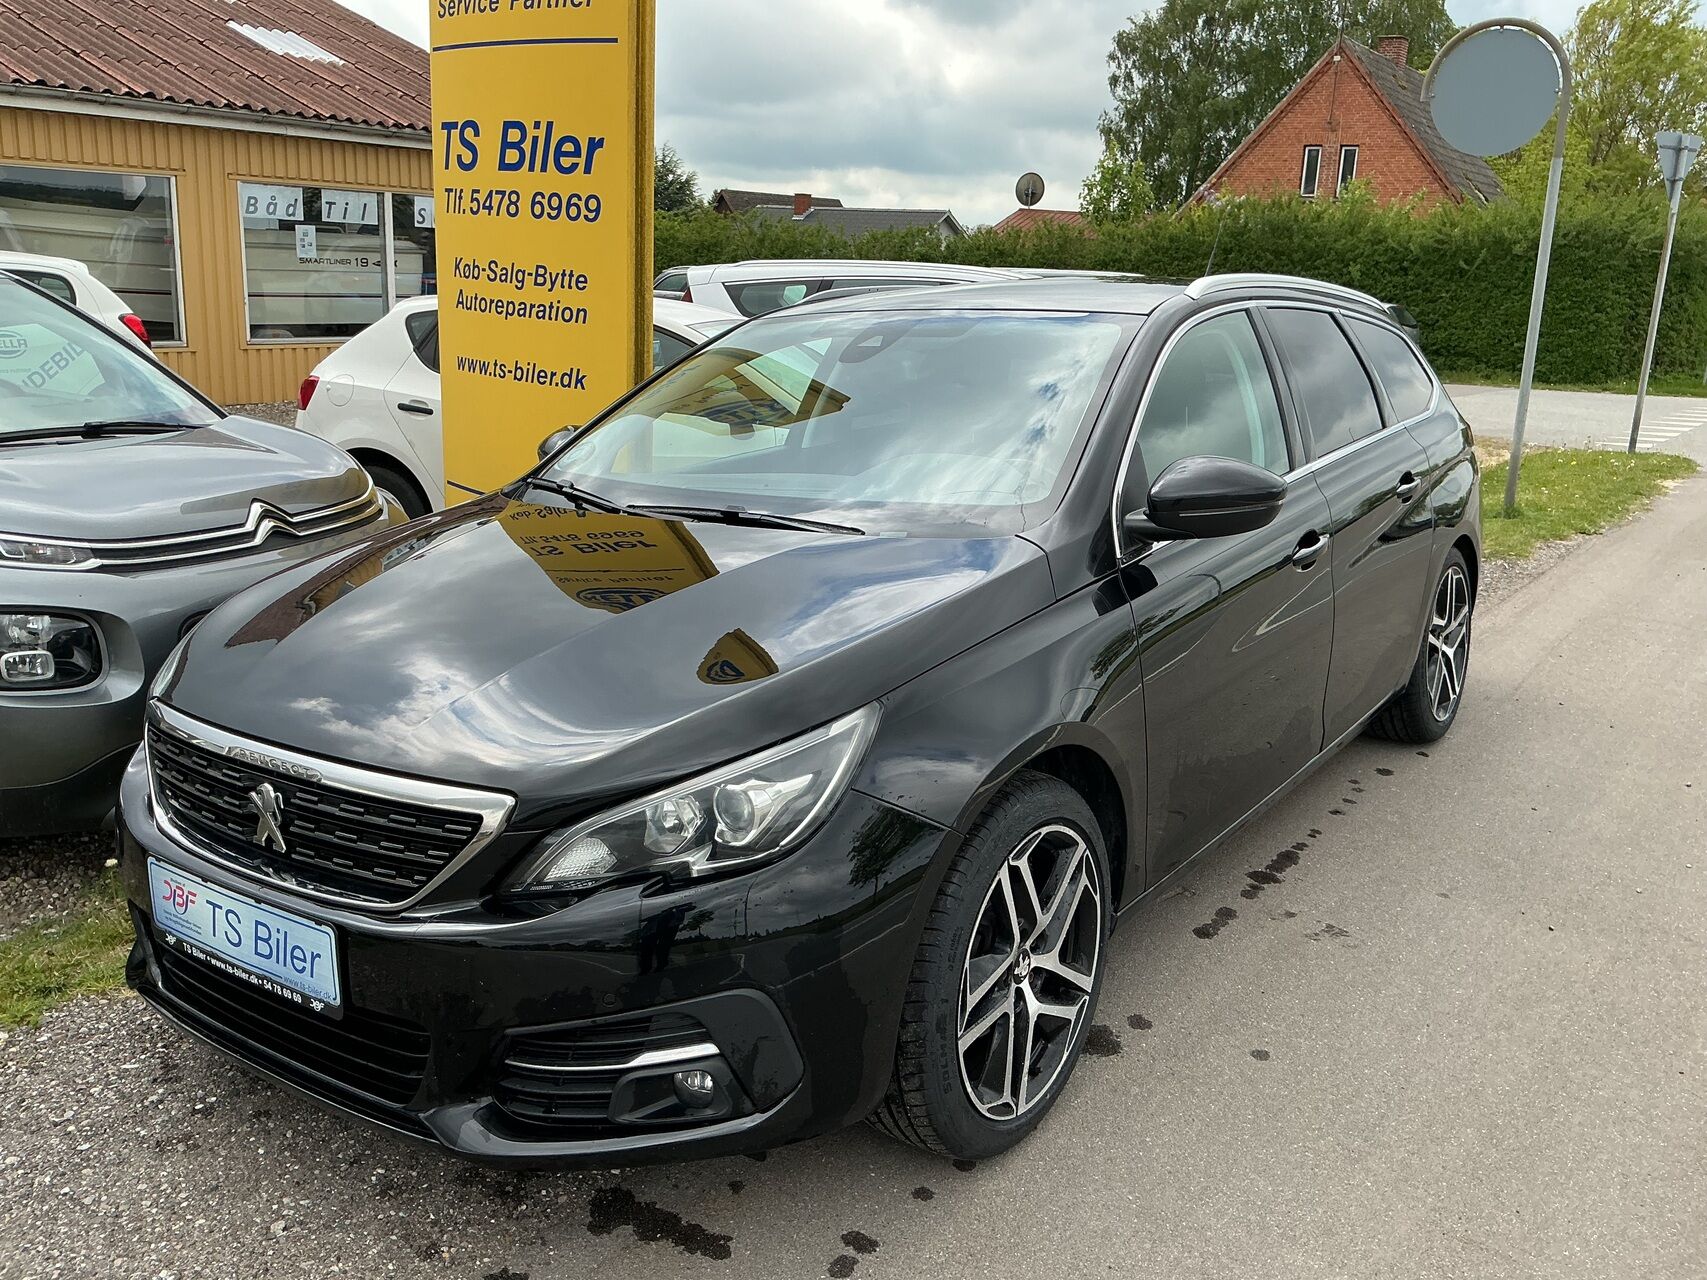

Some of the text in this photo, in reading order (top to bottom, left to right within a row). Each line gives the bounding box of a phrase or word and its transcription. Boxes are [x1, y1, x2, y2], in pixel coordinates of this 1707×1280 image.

[437, 0, 500, 18] Service
[440, 119, 605, 175] TS Biler
[244, 195, 299, 218] Båd
[325, 201, 368, 222] Til
[530, 191, 602, 223] 6969
[299, 257, 369, 268] SMARTLINER 19
[453, 257, 589, 292] Køb-Salg-Bytte
[455, 288, 589, 325] Autoreparation
[456, 355, 588, 391] www.ts-biler.dk
[239, 749, 310, 778] PEUGEOT
[206, 899, 321, 979] TS Biler
[182, 942, 192, 954] TS
[192, 946, 207, 961] Biler
[263, 979, 273, 991] 54
[273, 983, 282, 995] 78
[283, 989, 292, 1000] 69
[293, 992, 302, 1004] 69
